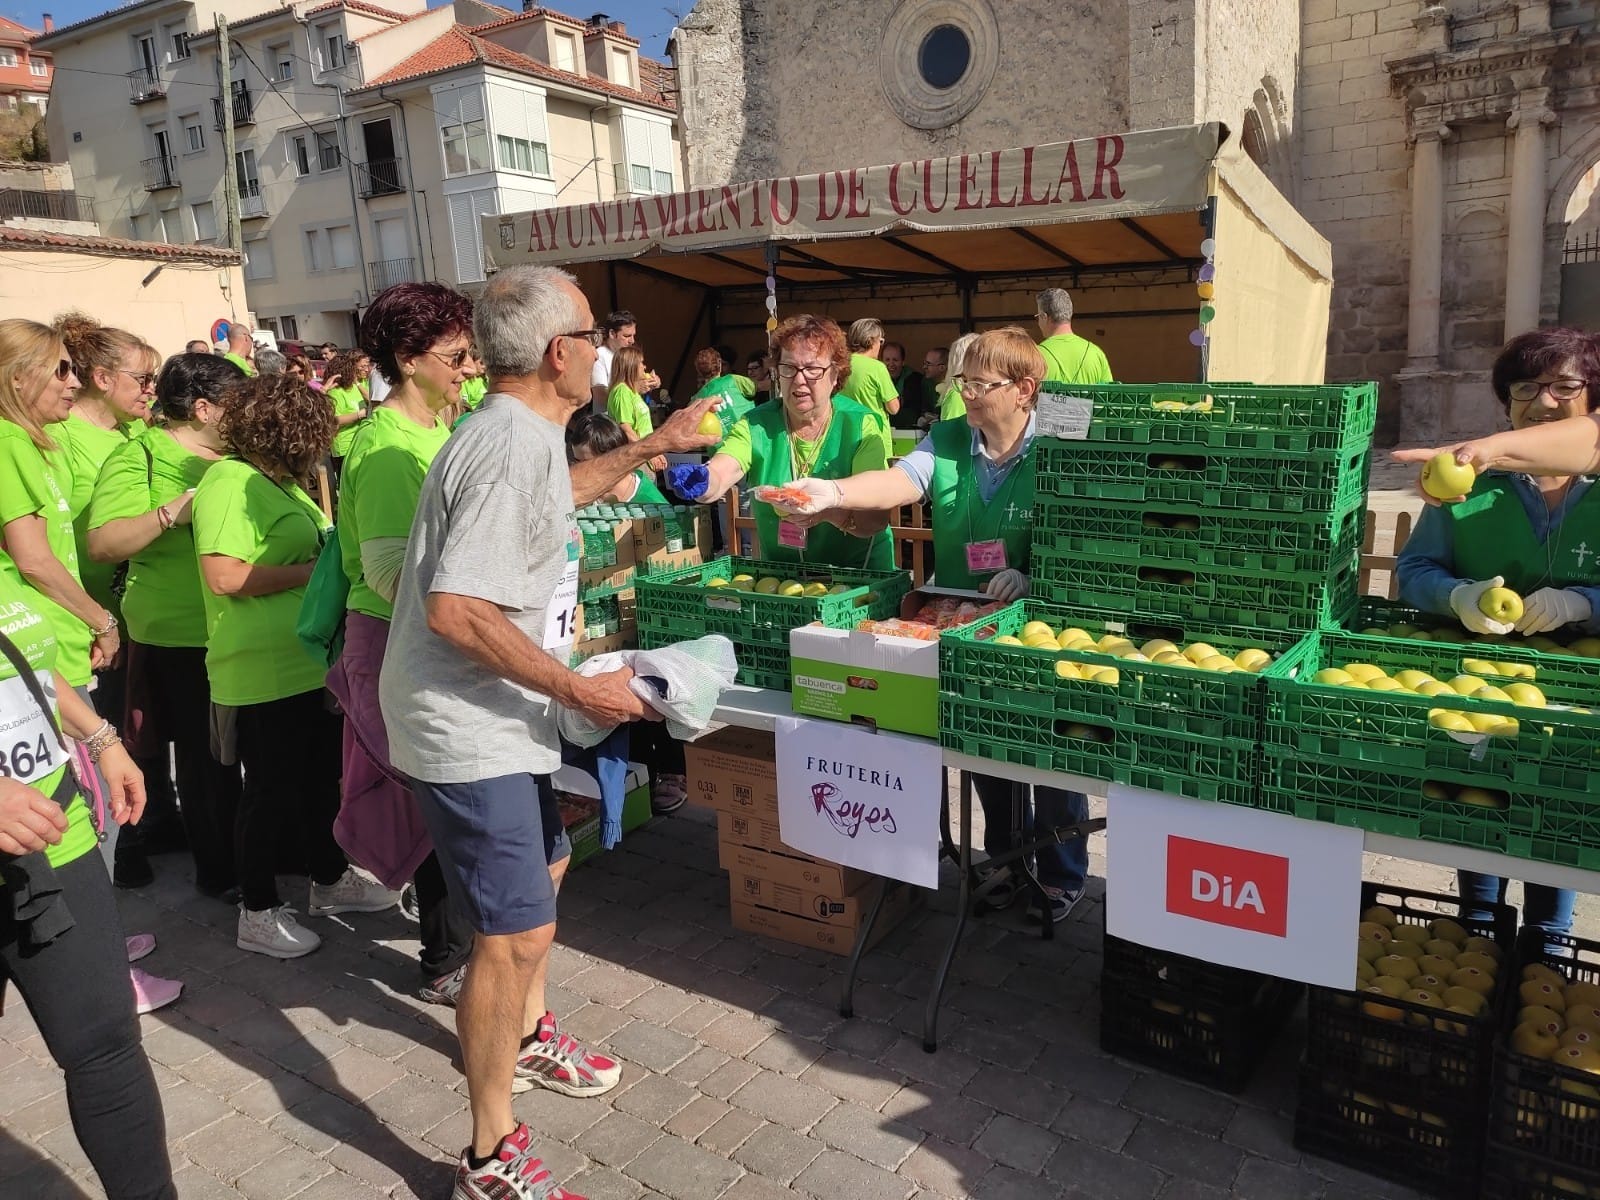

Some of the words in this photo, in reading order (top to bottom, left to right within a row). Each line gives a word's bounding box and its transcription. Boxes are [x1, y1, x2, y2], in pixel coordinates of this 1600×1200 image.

[528, 176, 799, 252] AYUNTAMIENTO
[816, 167, 871, 221] DE
[889, 134, 1126, 215] CUELLAR
[797, 676, 843, 692] tabuenca
[806, 756, 904, 791] FRUTERÍA
[809, 782, 897, 838] Reyes
